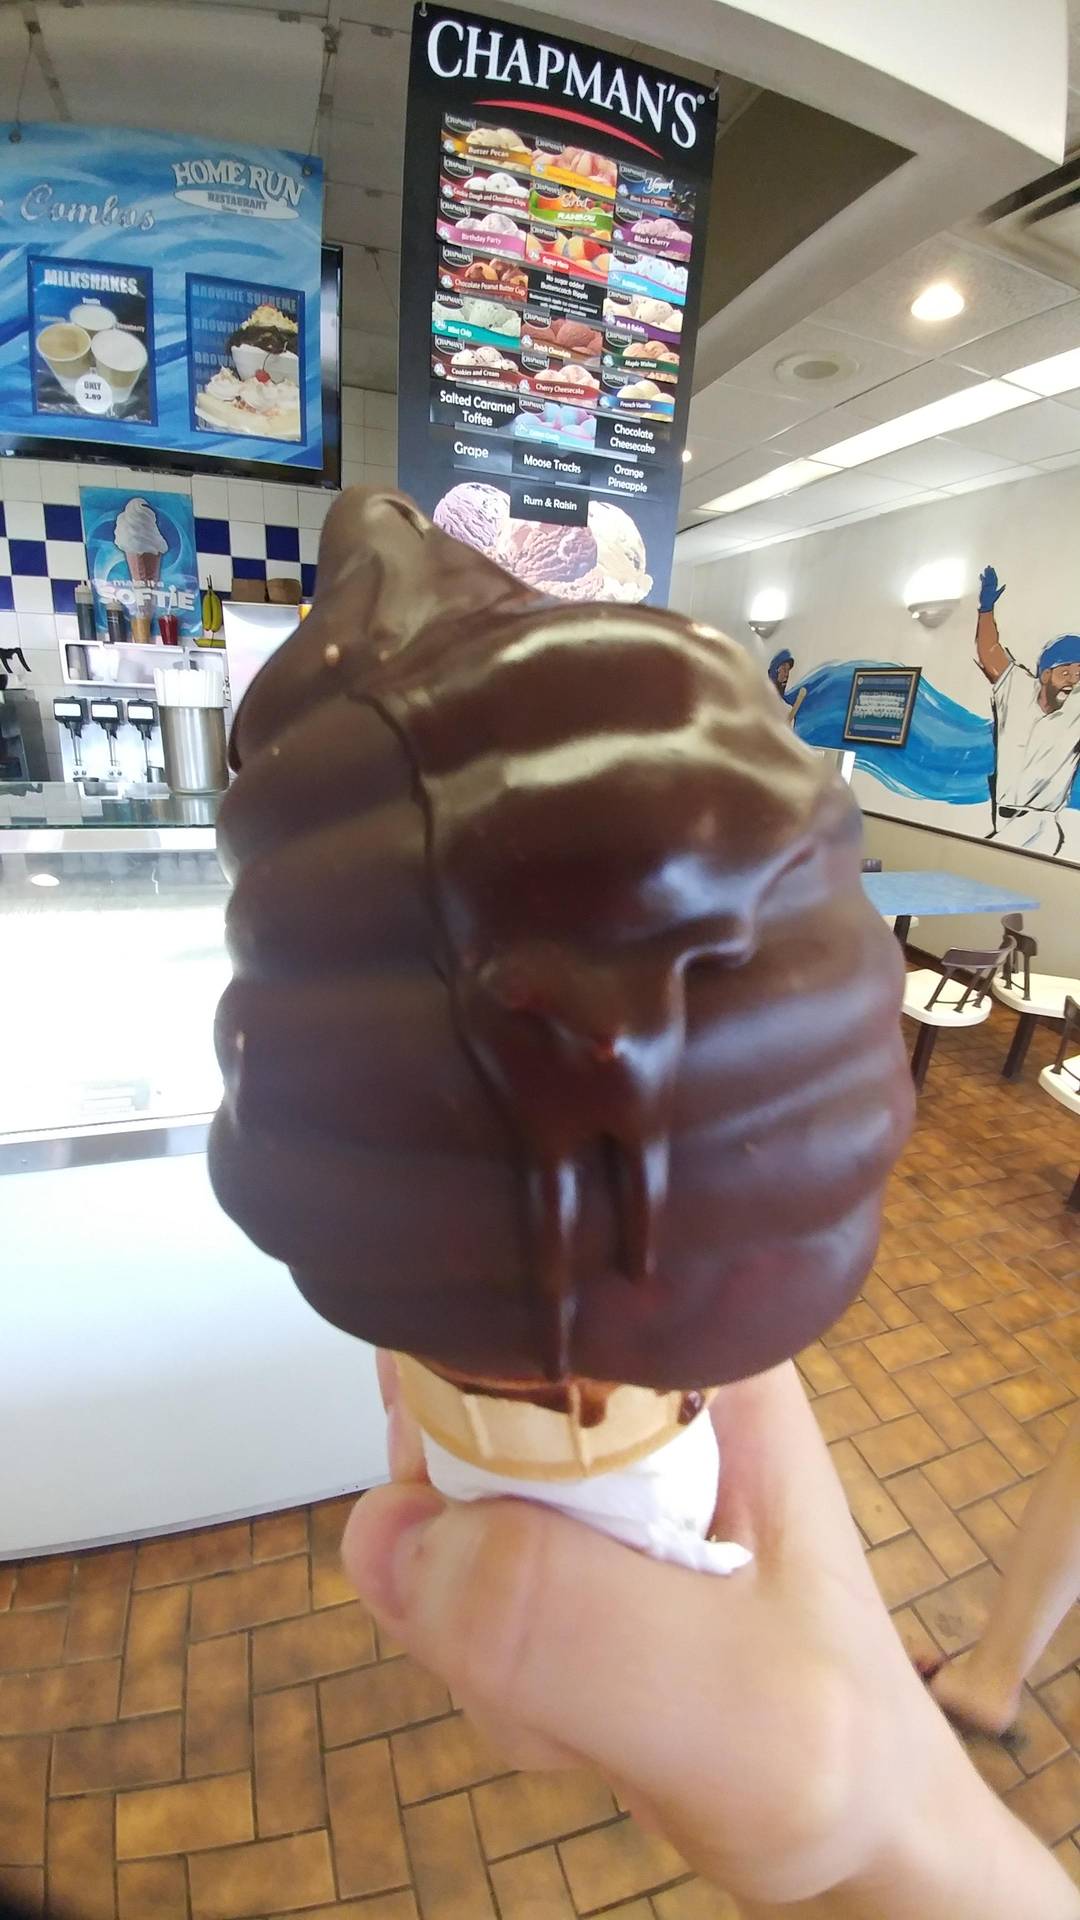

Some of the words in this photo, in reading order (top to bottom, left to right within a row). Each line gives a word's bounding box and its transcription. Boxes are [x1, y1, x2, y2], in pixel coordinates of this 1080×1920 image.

[427, 20, 697, 149] CHAPMAN'S
[468, 147, 489, 155] Butter
[490, 148, 509, 157] Pecan
[171, 159, 246, 188] HOME
[249, 165, 305, 206] RUN
[642, 177, 674, 194] Yogurt
[20, 183, 155, 231] Combos
[208, 191, 268, 211] RESTAURANT
[469, 193, 483, 202] Dough
[483, 193, 492, 201] and
[513, 197, 527, 206] Chips
[461, 233, 486, 243] Birthday
[486, 234, 502, 245] Party
[634, 234, 650, 243] Black
[650, 237, 670, 247] Cherry
[44, 268, 138, 296] MILKSHAKES
[454, 278, 481, 289] Chocolate
[480, 282, 499, 290] Peanut
[498, 284, 514, 292] Butter
[514, 286, 526, 296] Cup
[540, 281, 572, 295] Butterscotch
[546, 274, 554, 282] No
[554, 277, 569, 286] sugar
[568, 280, 585, 290] added
[192, 284, 244, 303] BROWNIE
[460, 327, 472, 337] Chip
[451, 367, 472, 375] Cookies
[472, 368, 482, 376] and
[482, 369, 500, 378] Cream
[535, 383, 553, 393] Cherry
[554, 385, 584, 395] Cheesecake
[440, 390, 471, 407] Salted
[473, 396, 516, 414] Caramel
[620, 401, 636, 409] French
[462, 410, 493, 426] Toffee
[614, 423, 654, 440] Chocolate
[453, 441, 489, 458] Grape
[610, 437, 656, 454] Cheesecake
[523, 454, 552, 469] Moose
[553, 459, 582, 474] Tracks
[614, 463, 645, 479] Orange
[607, 476, 648, 493] Pineapple
[523, 495, 543, 506] Rum
[544, 498, 552, 507] &
[553, 498, 577, 511] Raisin
